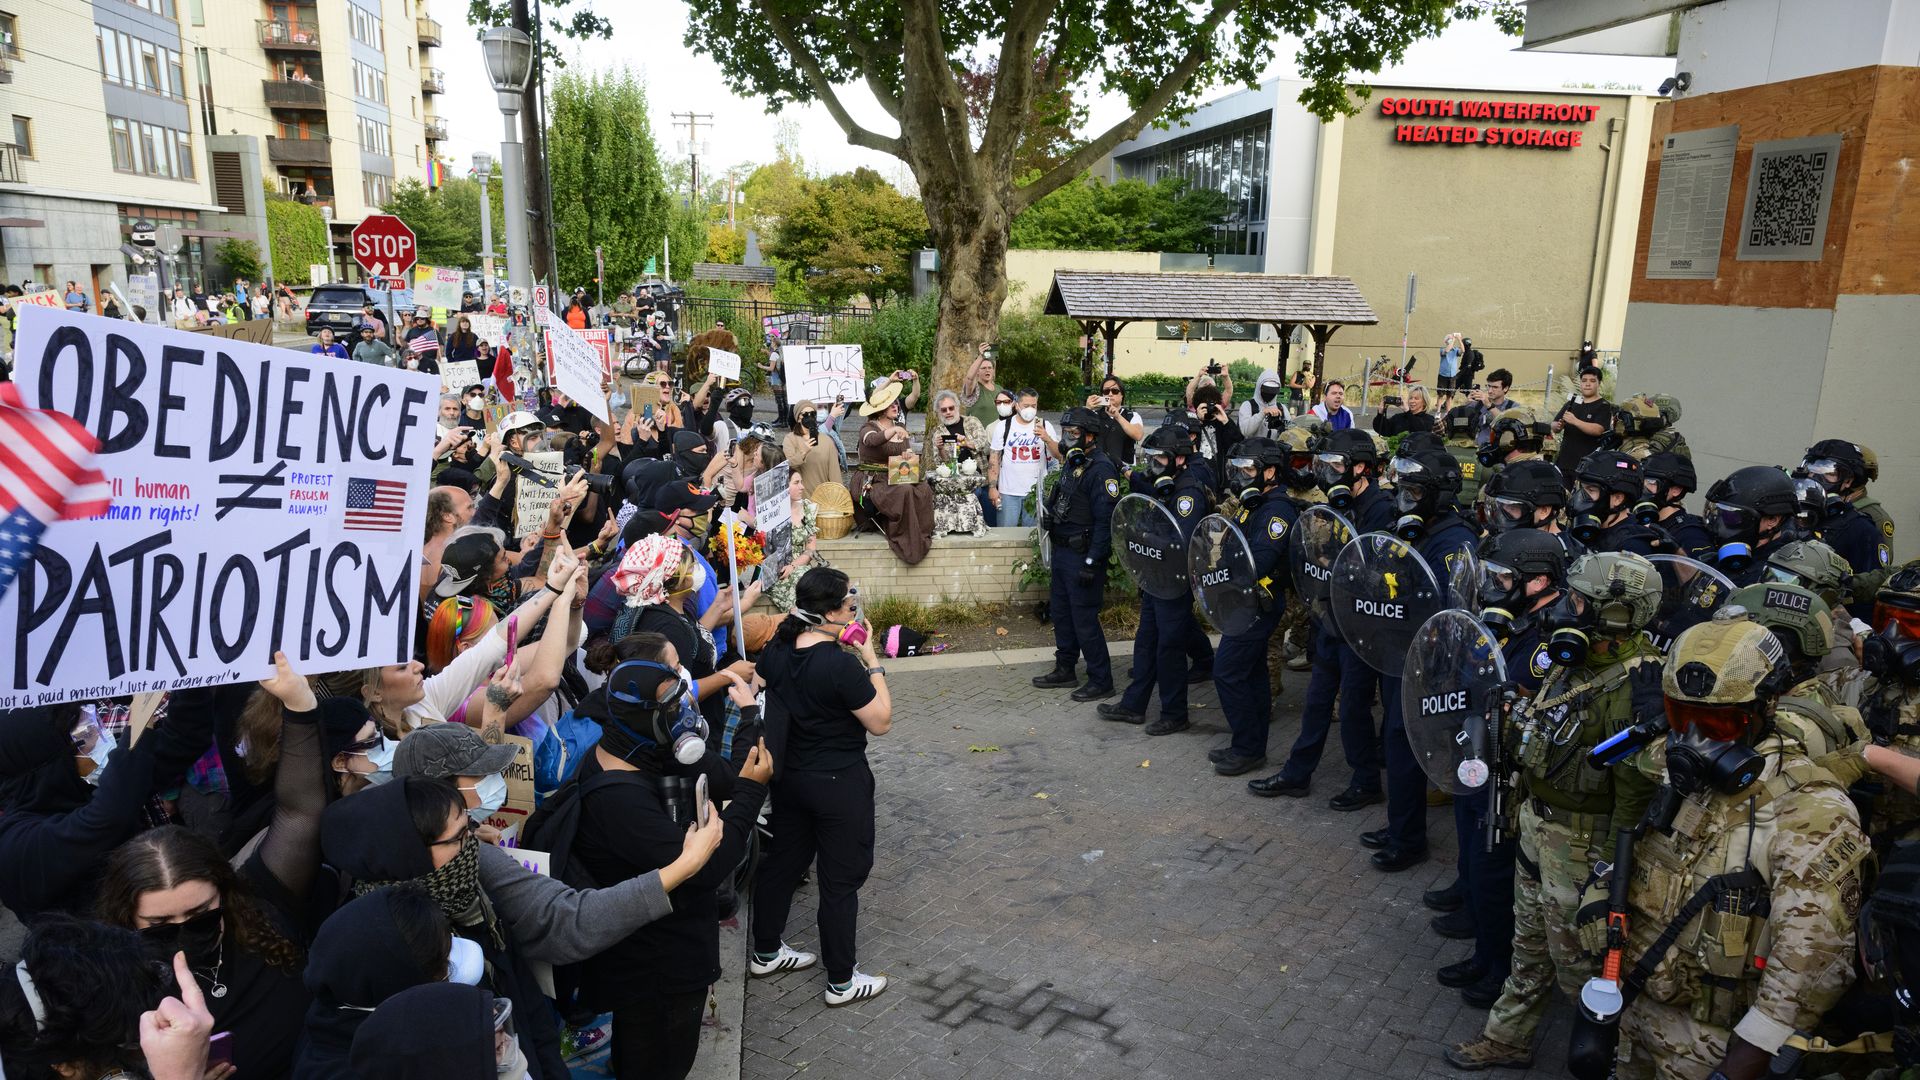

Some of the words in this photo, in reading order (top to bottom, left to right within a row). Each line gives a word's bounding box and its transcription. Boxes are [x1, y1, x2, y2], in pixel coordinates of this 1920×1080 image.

[1381, 97, 1454, 117] SOUTH
[1461, 100, 1600, 122] WATERFRONT
[1396, 124, 1478, 143] HEATED
[1486, 128, 1583, 148] STORAGE
[357, 233, 412, 258] STOP
[1670, 259, 1692, 267] WARNING
[437, 275, 459, 283] LIGHT
[1480, 327, 1518, 340] MISSED
[446, 367, 464, 377] STOP
[804, 346, 861, 378] FUCK
[38, 326, 428, 467] OBEDIENCE
[802, 376, 859, 401] ICE!
[1011, 445, 1041, 461] ICE
[540, 460, 559, 471] STATE
[135, 477, 190, 499] human
[291, 472, 334, 487] PROTEST
[289, 489, 329, 501] FASCISM
[149, 502, 200, 527] rights!
[288, 504, 328, 516] ALWAYS!
[757, 504, 769, 515] WILL
[1128, 541, 1162, 560] POLICE
[1202, 568, 1230, 587] POLICE
[1304, 562, 1332, 582] POLIC
[13, 528, 413, 690] PATRIOTISM
[1355, 599, 1404, 619] POLICE
[1767, 590, 1809, 611] POLICE
[22, 694, 34, 706] a
[37, 687, 65, 706] paid
[69, 683, 124, 700] protestor!
[127, 680, 148, 694] Just
[152, 680, 167, 690] an
[171, 676, 203, 692] angry
[205, 669, 231, 687] girl!
[1421, 690, 1467, 715] POLICE
[1834, 838, 1857, 861] 816
